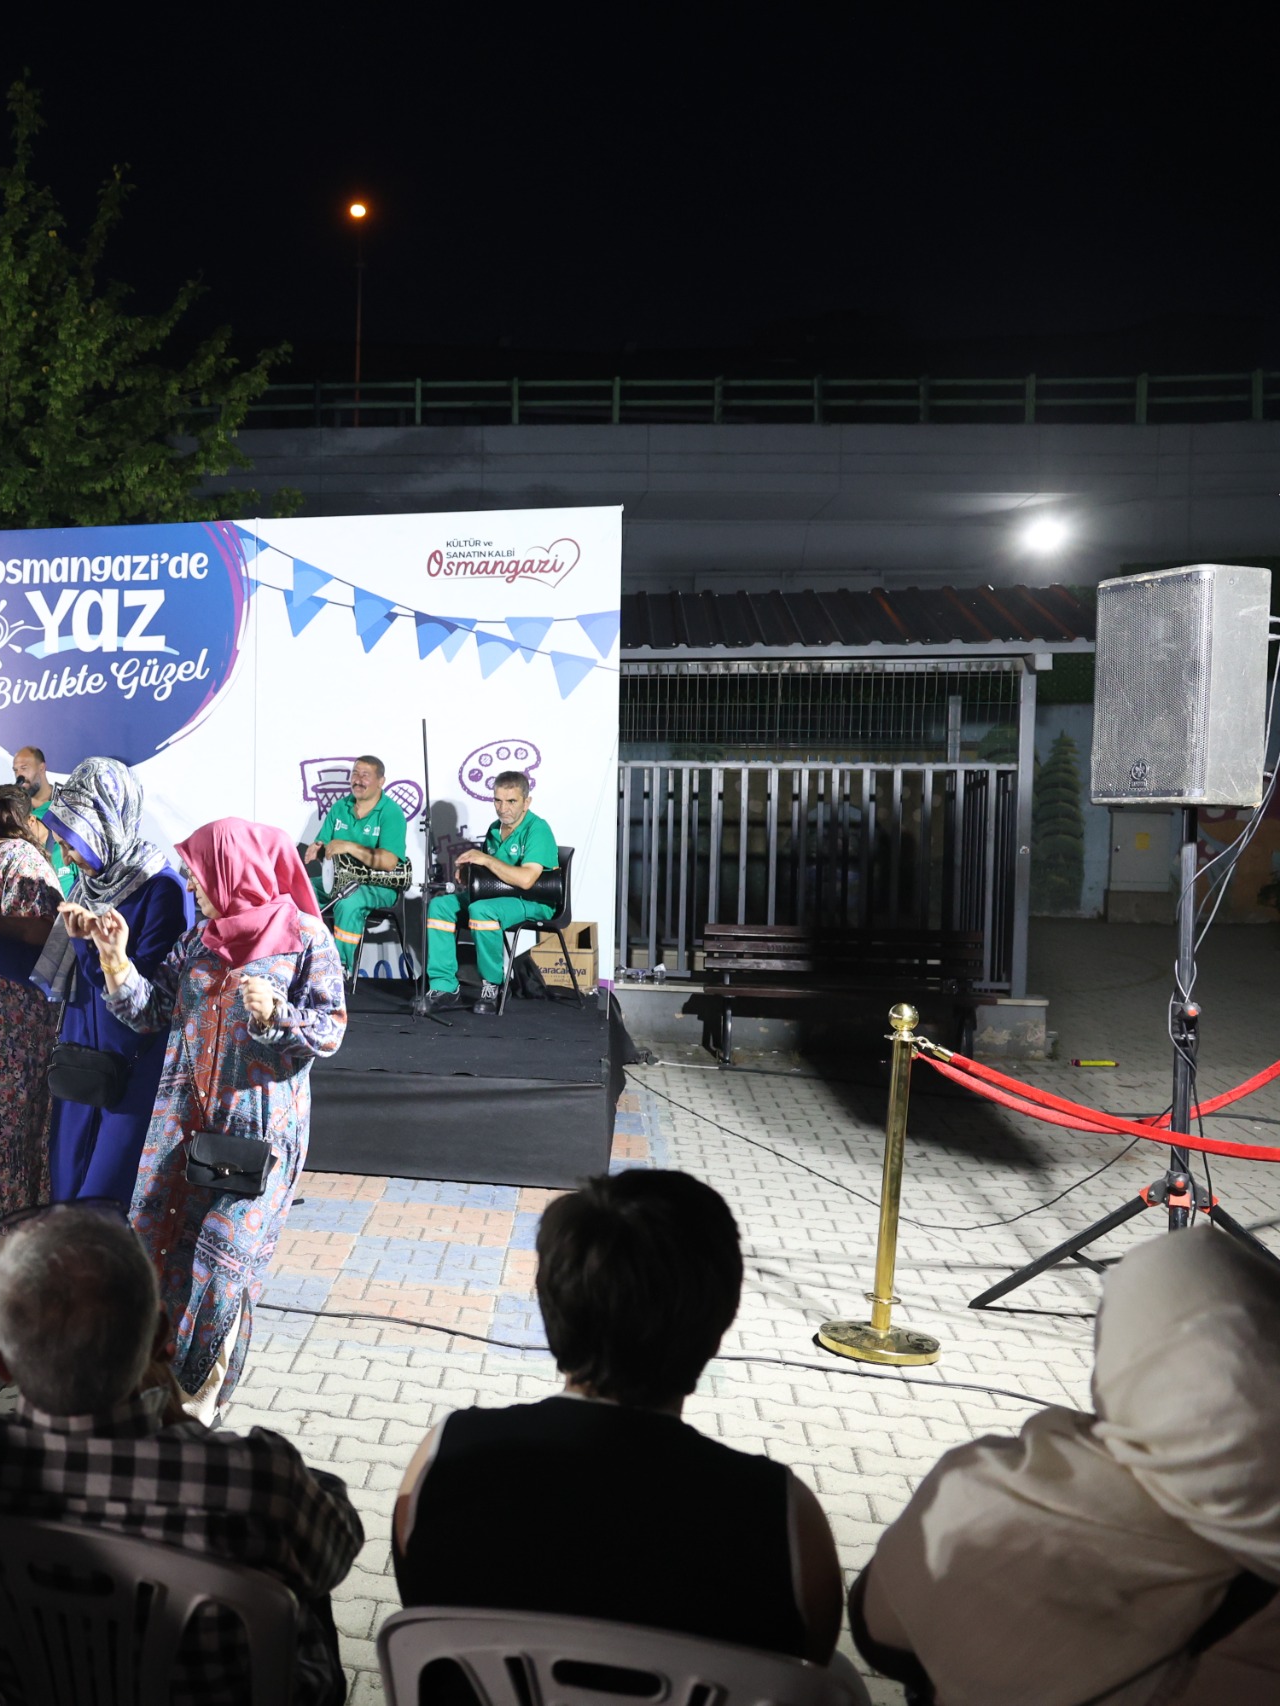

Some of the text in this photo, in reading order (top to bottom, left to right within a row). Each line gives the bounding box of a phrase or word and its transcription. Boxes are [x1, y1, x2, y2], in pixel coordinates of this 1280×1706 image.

[446, 537, 481, 548] KÜLTÜR
[446, 547, 515, 559] SANATIN KALBİ
[427, 550, 565, 584] Osmangazi
[110, 648, 210, 702] Güzel
